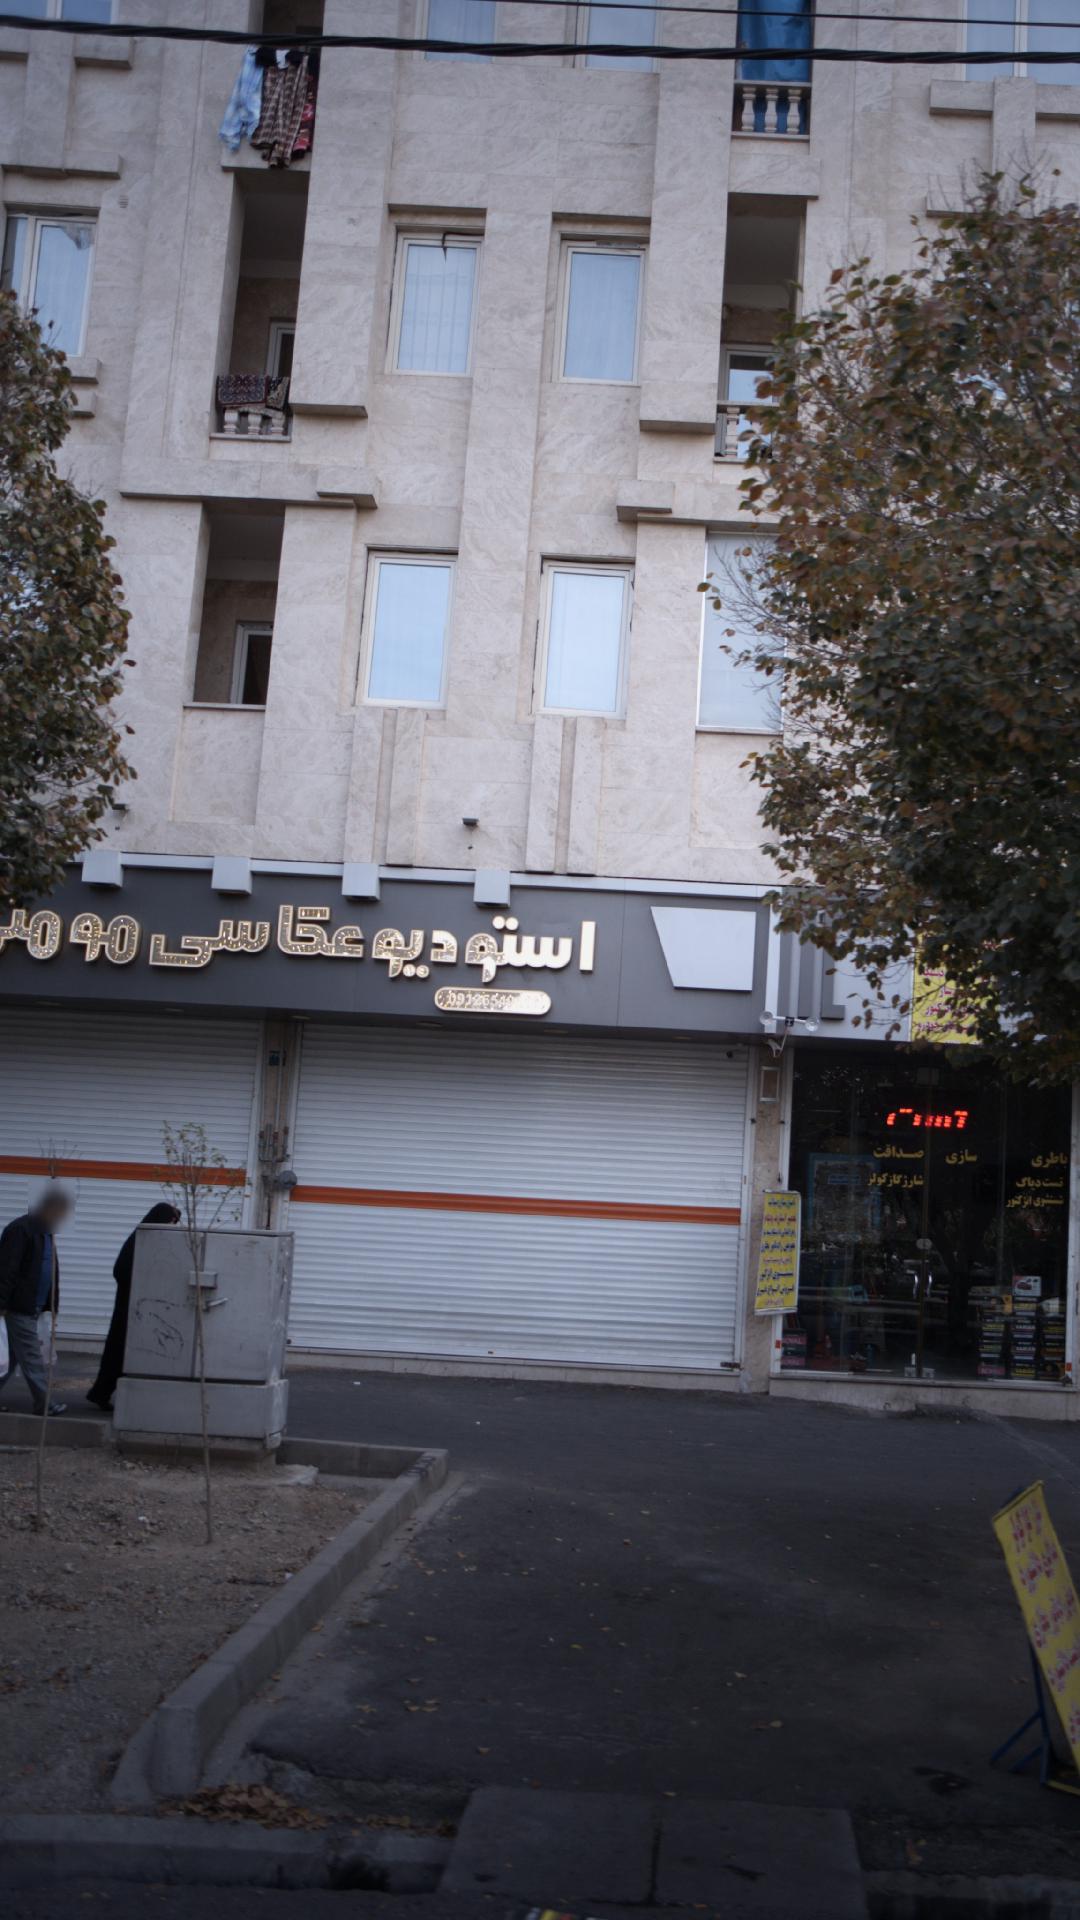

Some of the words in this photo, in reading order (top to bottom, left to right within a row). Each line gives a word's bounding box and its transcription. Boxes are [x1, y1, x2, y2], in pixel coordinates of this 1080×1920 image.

[149, 904, 365, 968] عکاسی
[372, 915, 597, 983] استودیو
[872, 1144, 924, 1160] صداقت
[945, 1148, 977, 1165] سازی
